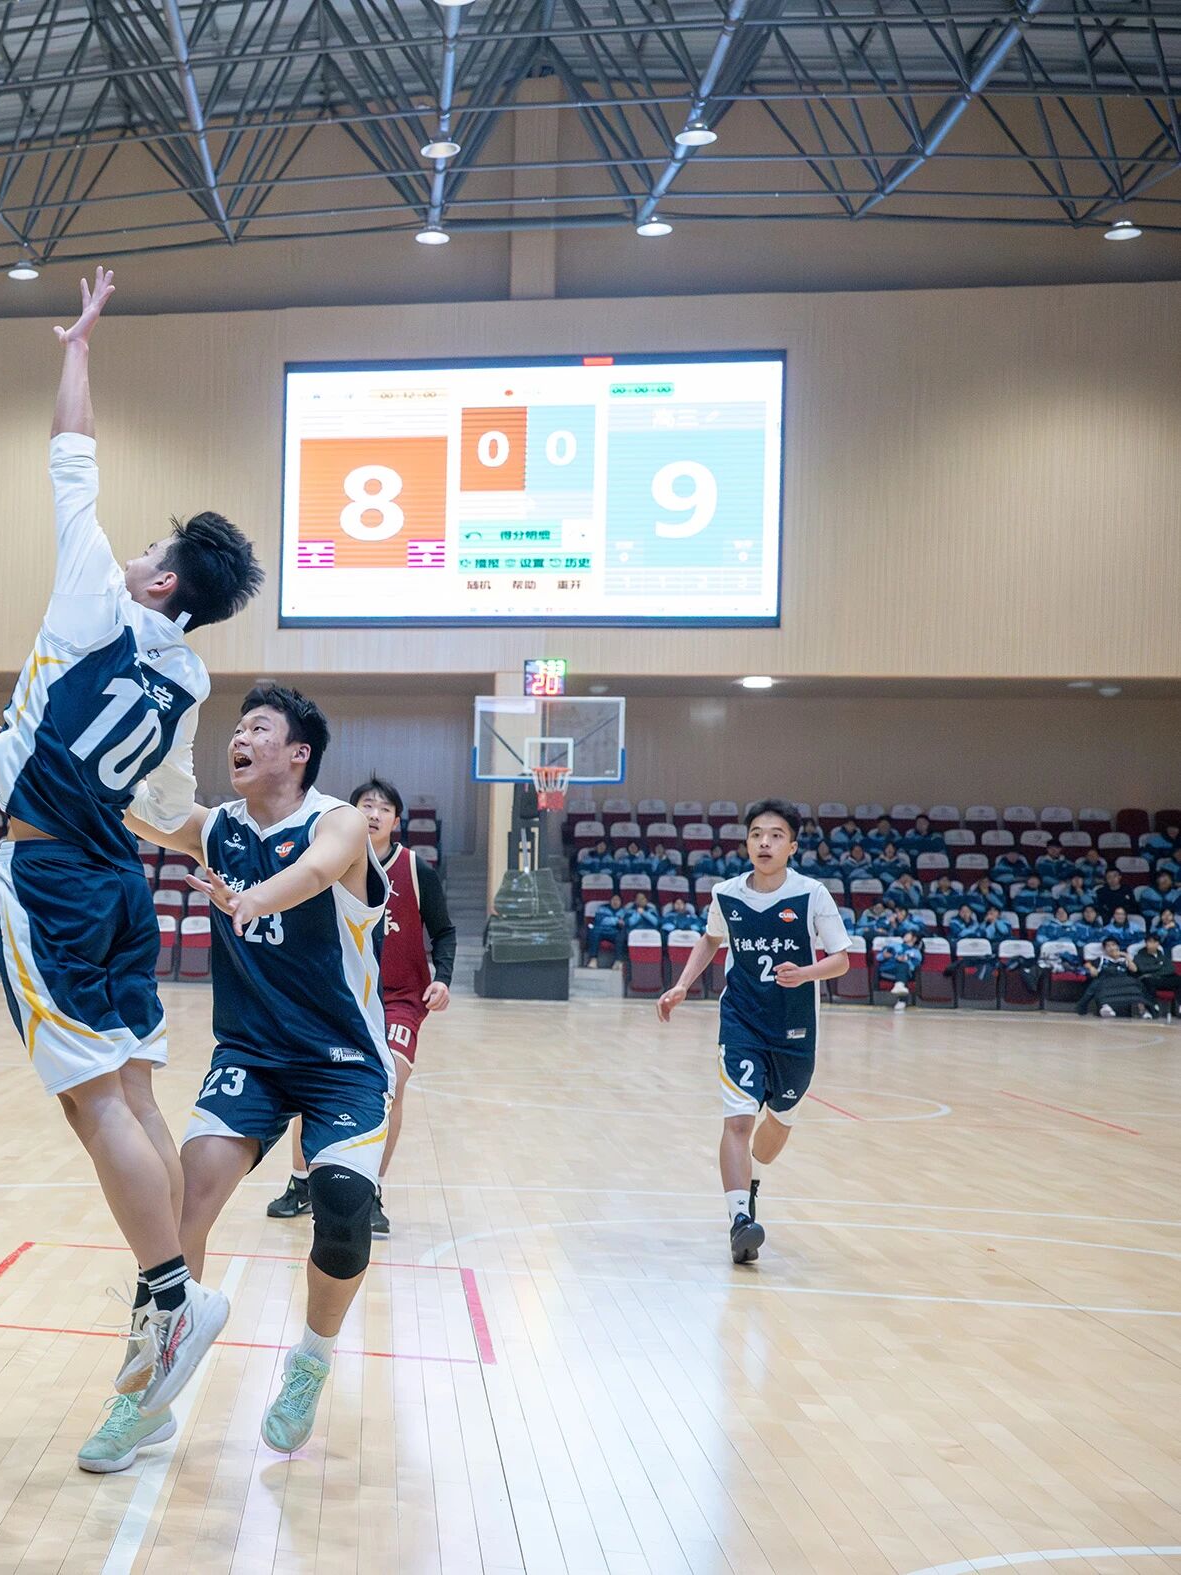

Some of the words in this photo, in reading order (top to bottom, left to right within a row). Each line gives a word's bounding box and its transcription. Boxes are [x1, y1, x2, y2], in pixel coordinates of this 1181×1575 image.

[478, 430, 509, 467] 0
[546, 430, 577, 466] 0
[340, 464, 404, 541] 8
[651, 460, 717, 538] 9
[564, 558, 590, 568] 历史
[532, 674, 558, 695] 20
[69, 677, 162, 791] 10
[245, 912, 285, 946] 23
[757, 955, 775, 983] 2
[387, 1023, 412, 1048] 10
[200, 1067, 247, 1100] 23
[739, 1059, 755, 1087] 2
